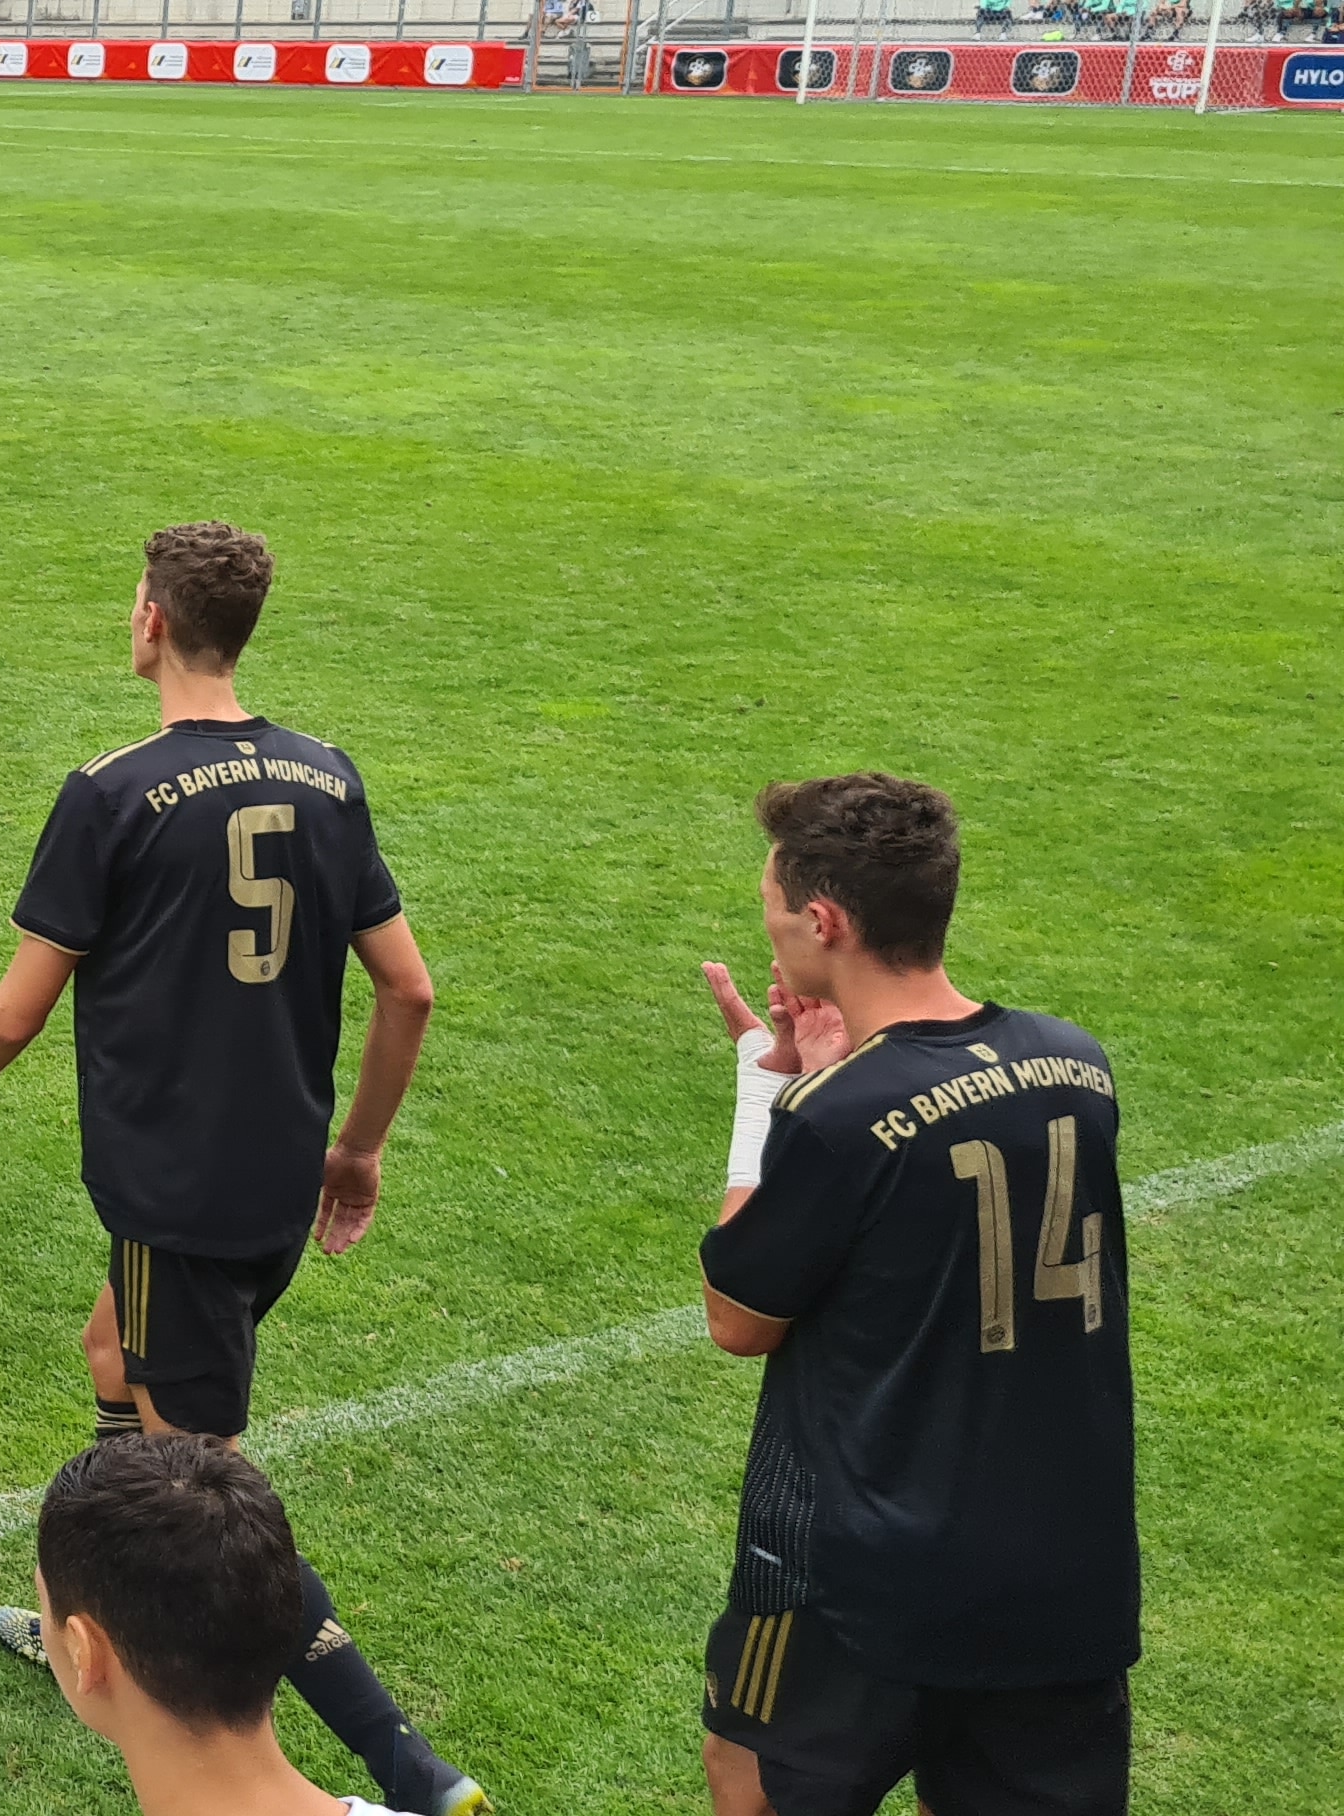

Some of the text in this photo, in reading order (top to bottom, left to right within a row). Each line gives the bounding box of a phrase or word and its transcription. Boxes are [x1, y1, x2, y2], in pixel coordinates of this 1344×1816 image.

[1152, 83, 1198, 99] CUP
[1294, 70, 1344, 85] HYLO
[145, 783, 179, 814] FC
[176, 758, 261, 798] BAYERN
[226, 803, 295, 983] 5
[870, 1109, 917, 1151] FC
[909, 1065, 1016, 1125] BAYERN
[948, 1114, 1104, 1354] 14
